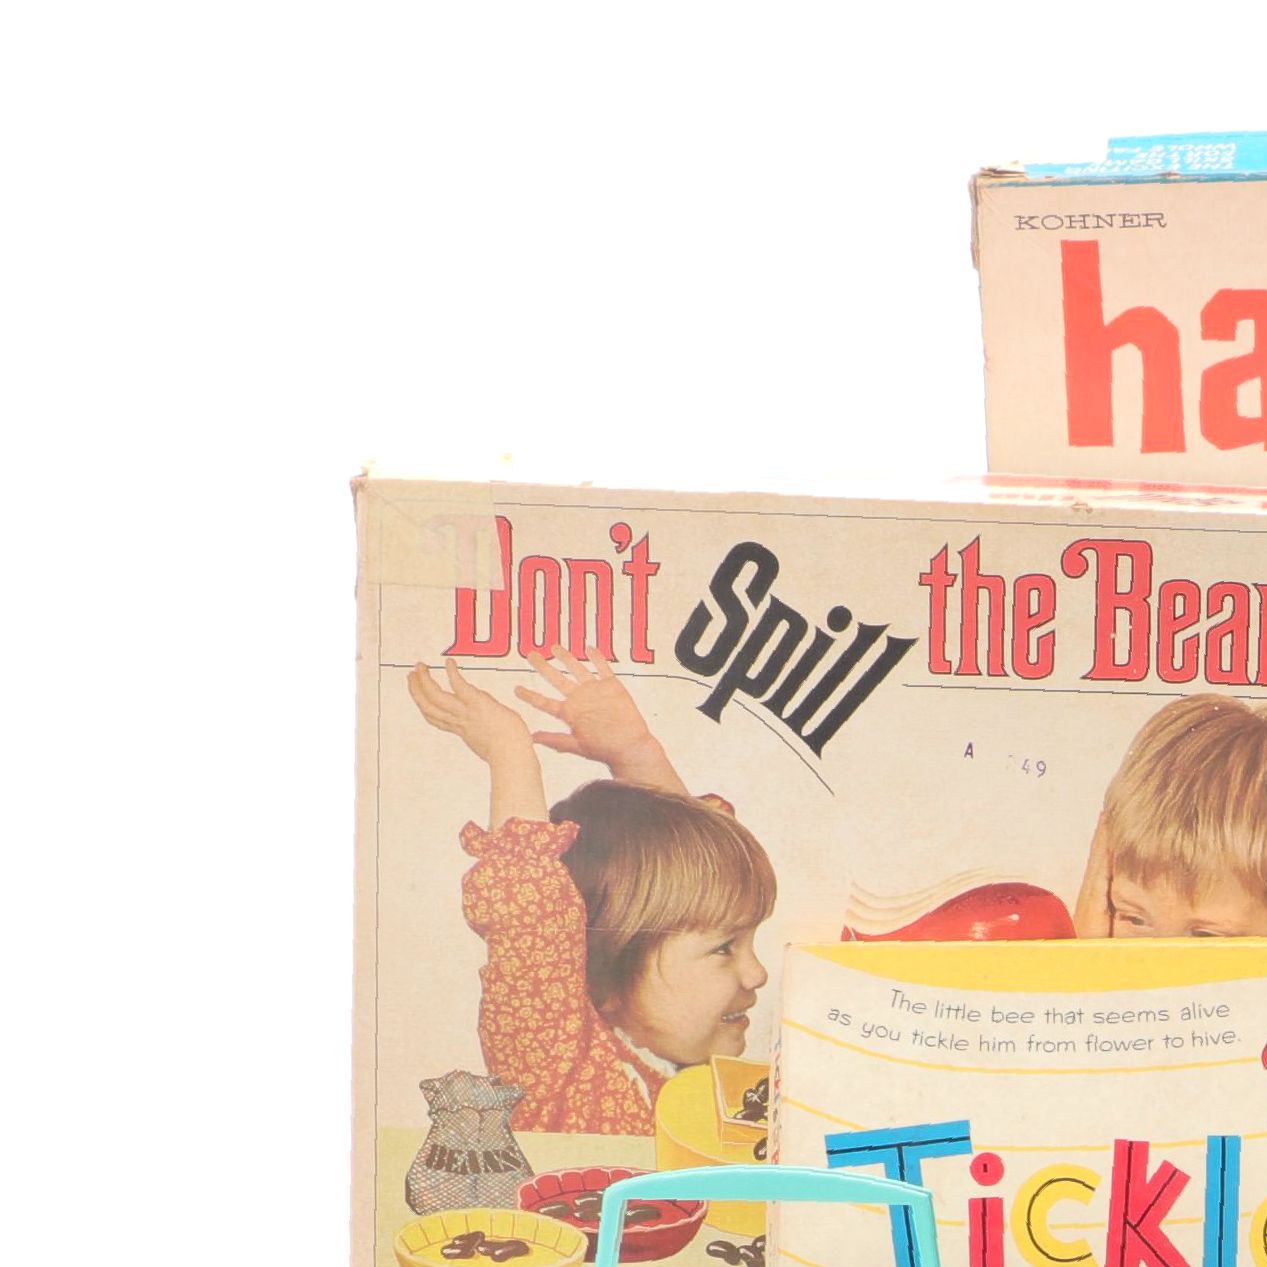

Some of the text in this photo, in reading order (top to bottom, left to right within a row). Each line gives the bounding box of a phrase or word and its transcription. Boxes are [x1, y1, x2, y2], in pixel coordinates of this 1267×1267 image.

[1015, 213, 1167, 231] KOHNER
[428, 515, 660, 664] Don't
[674, 541, 920, 760] Spill
[918, 534, 1057, 680] the
[889, 987, 1231, 1026] The little bee that seems alive
[825, 1007, 1242, 1054] as you tickle him from flower to hive.
[424, 1144, 523, 1175] BEANS
